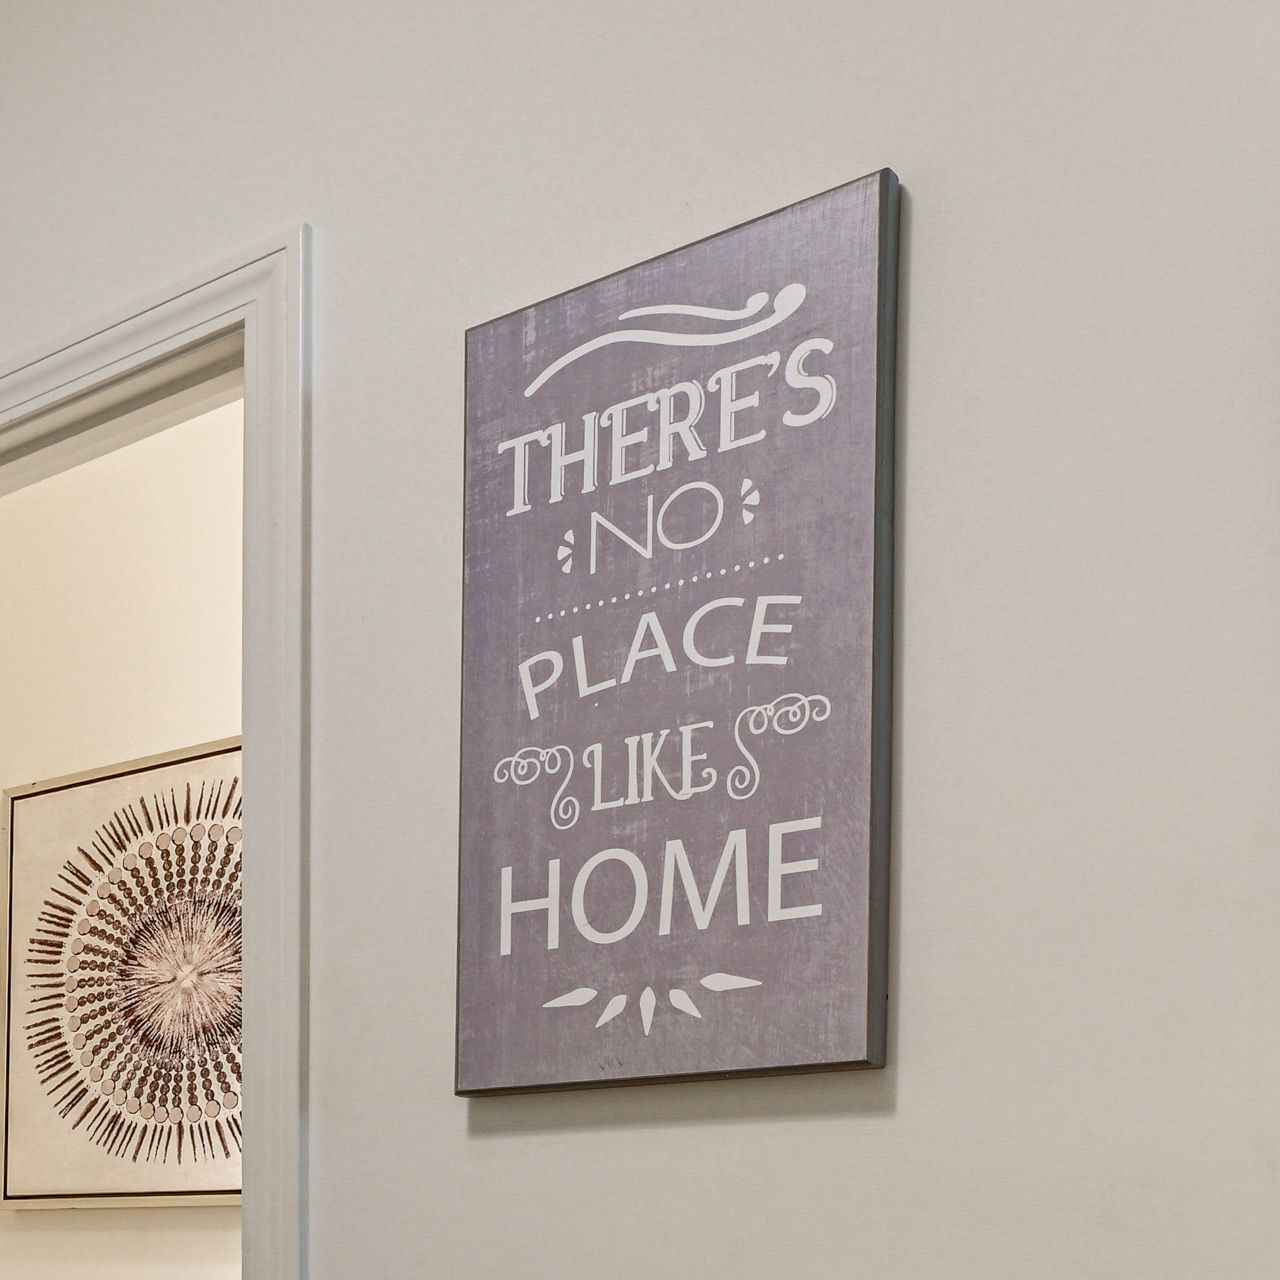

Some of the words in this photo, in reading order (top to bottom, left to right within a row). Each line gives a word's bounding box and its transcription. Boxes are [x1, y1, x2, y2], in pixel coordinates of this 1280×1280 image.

[497, 337, 838, 517] THERE'S
[590, 481, 725, 575] NO
[517, 595, 802, 720] PLACE
[582, 720, 718, 812] LIKE
[499, 816, 823, 956] HOME
